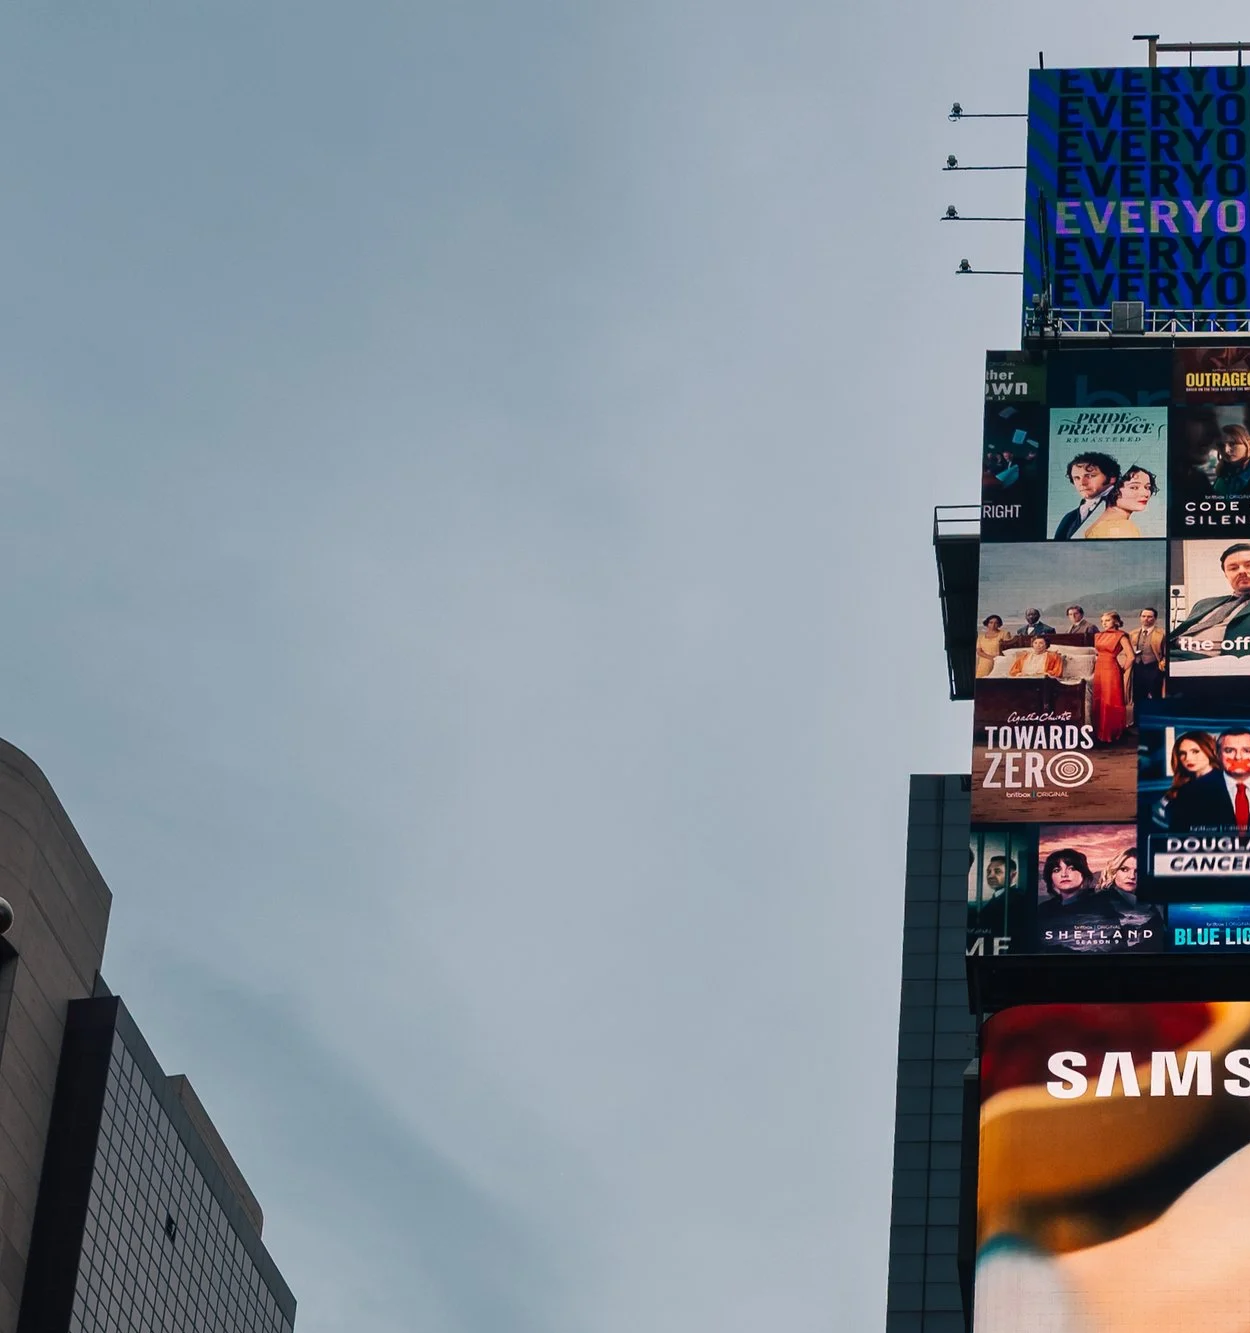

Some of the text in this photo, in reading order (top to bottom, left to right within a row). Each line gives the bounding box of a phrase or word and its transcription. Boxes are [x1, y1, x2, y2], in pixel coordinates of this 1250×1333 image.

[1077, 412, 1132, 424] PRIDE
[1057, 423, 1155, 435] PREJUDICE
[1185, 501, 1240, 511] CODE
[1179, 635, 1215, 651] the
[984, 725, 1094, 750] TOWARDS
[982, 751, 1094, 788] ZERO
[1045, 929, 1153, 940] SHETLAND
[1174, 928, 1220, 945] BLUE
